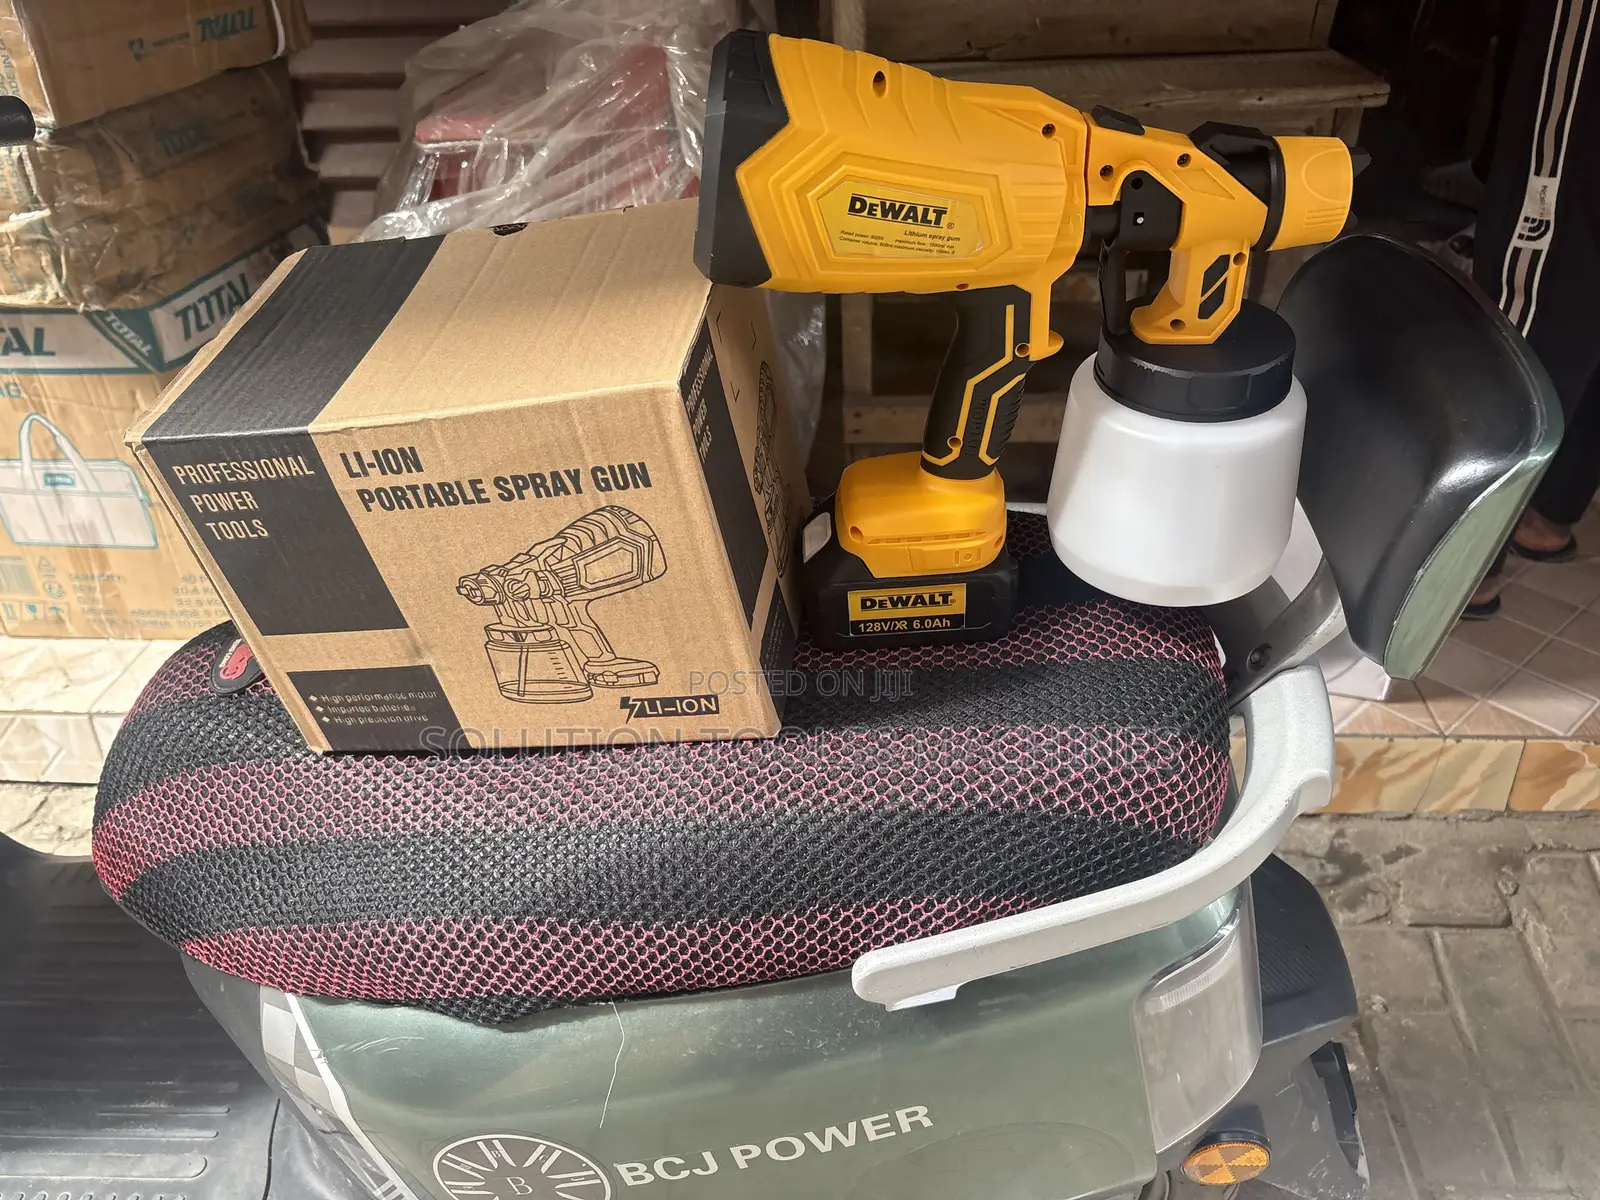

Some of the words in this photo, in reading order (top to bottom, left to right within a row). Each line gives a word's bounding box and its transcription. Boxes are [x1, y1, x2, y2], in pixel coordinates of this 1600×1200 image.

[0, 326, 57, 356] AL
[172, 455, 315, 485] PROFESSIONAL
[339, 446, 424, 479] LI-ION
[356, 478, 491, 513] PORTABLE
[493, 468, 584, 502] SPRAY
[590, 461, 652, 492] GUN
[190, 490, 259, 514] POWER
[206, 519, 269, 541] TOOLS
[912, 618, 951, 629] 6.0Ah
[321, 695, 344, 705] High
[644, 696, 718, 716] LI-ION
[616, 1151, 720, 1187] BCJ
[730, 1104, 935, 1170] POWER
